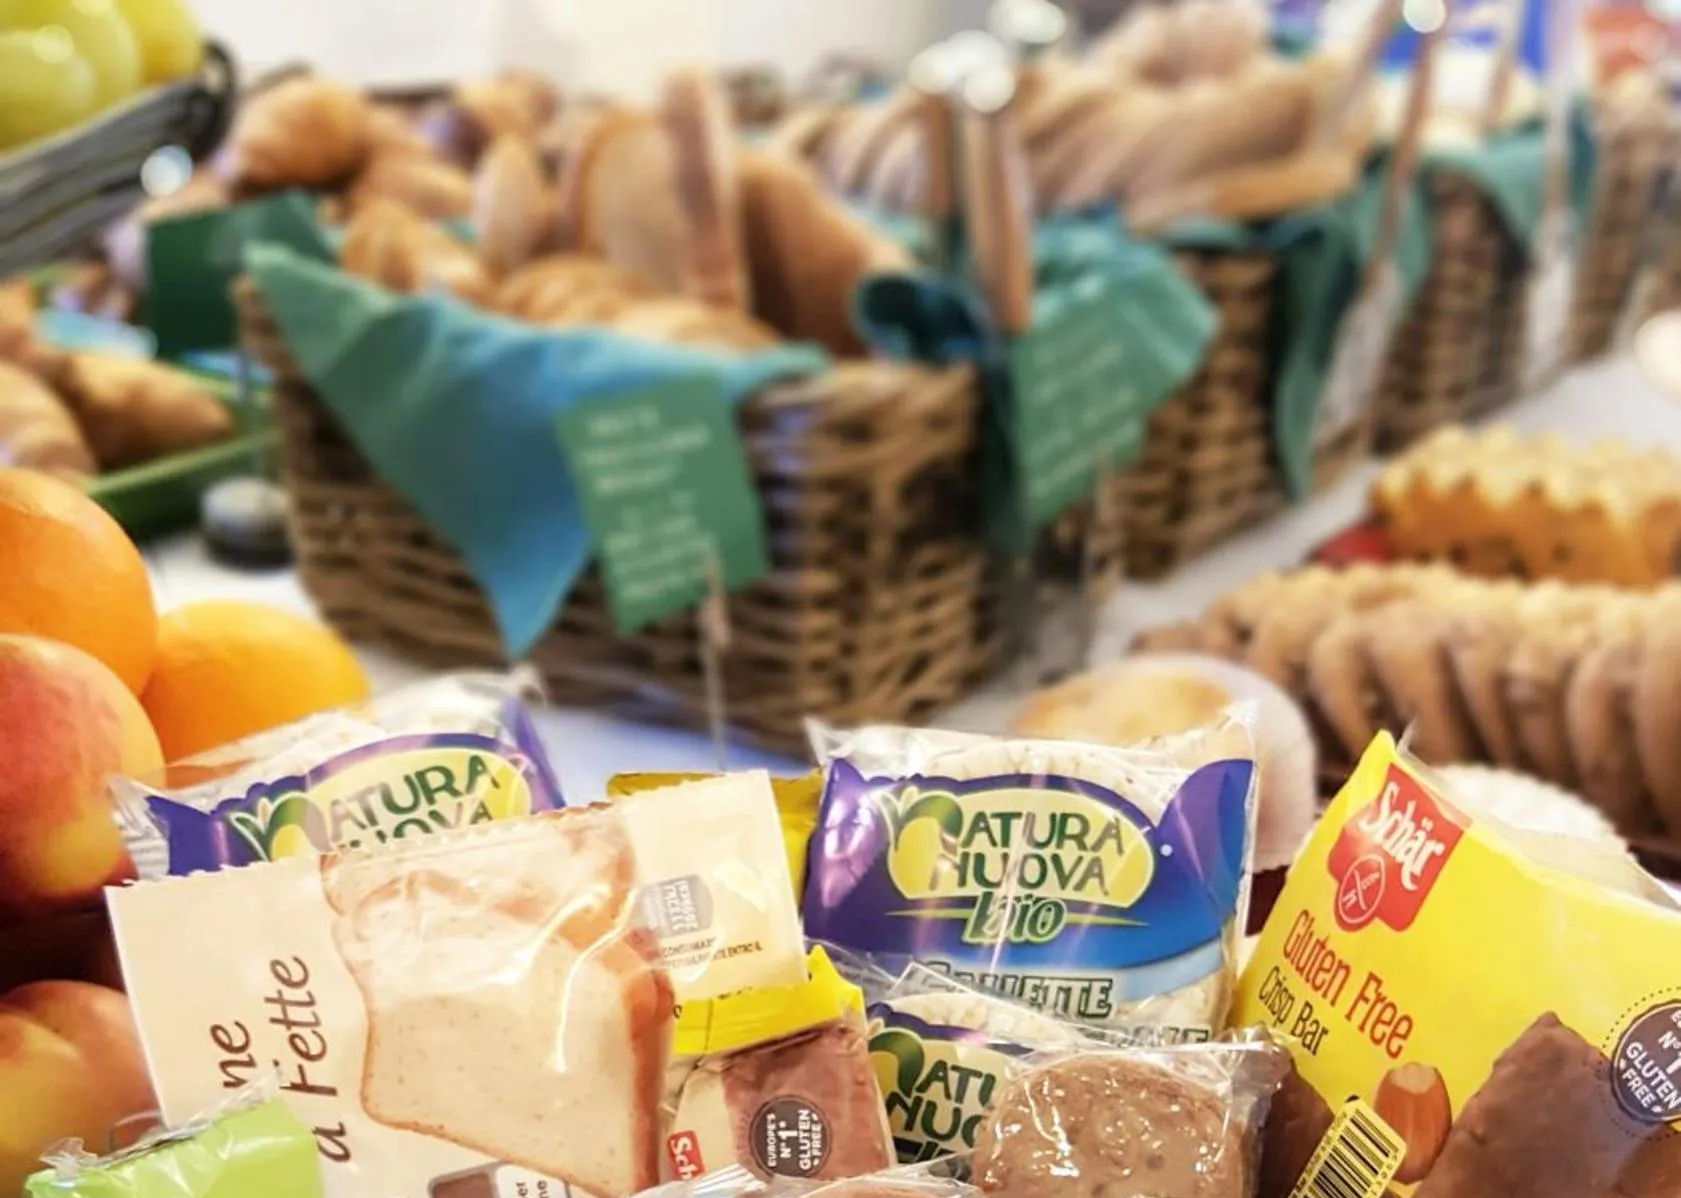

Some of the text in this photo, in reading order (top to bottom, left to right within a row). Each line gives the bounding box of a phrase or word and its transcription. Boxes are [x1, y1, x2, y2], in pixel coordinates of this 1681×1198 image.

[1359, 782, 1446, 891] Schär
[929, 848, 1109, 897] NUOVA
[963, 889, 1069, 944] bio
[1258, 965, 1330, 1056] Crisp Bar
[1283, 908, 1414, 1060] Gluten Free
[1621, 1067, 1657, 1109] FREE
[798, 1109, 812, 1171] GLUTEN
[811, 1122, 823, 1157] FREE
